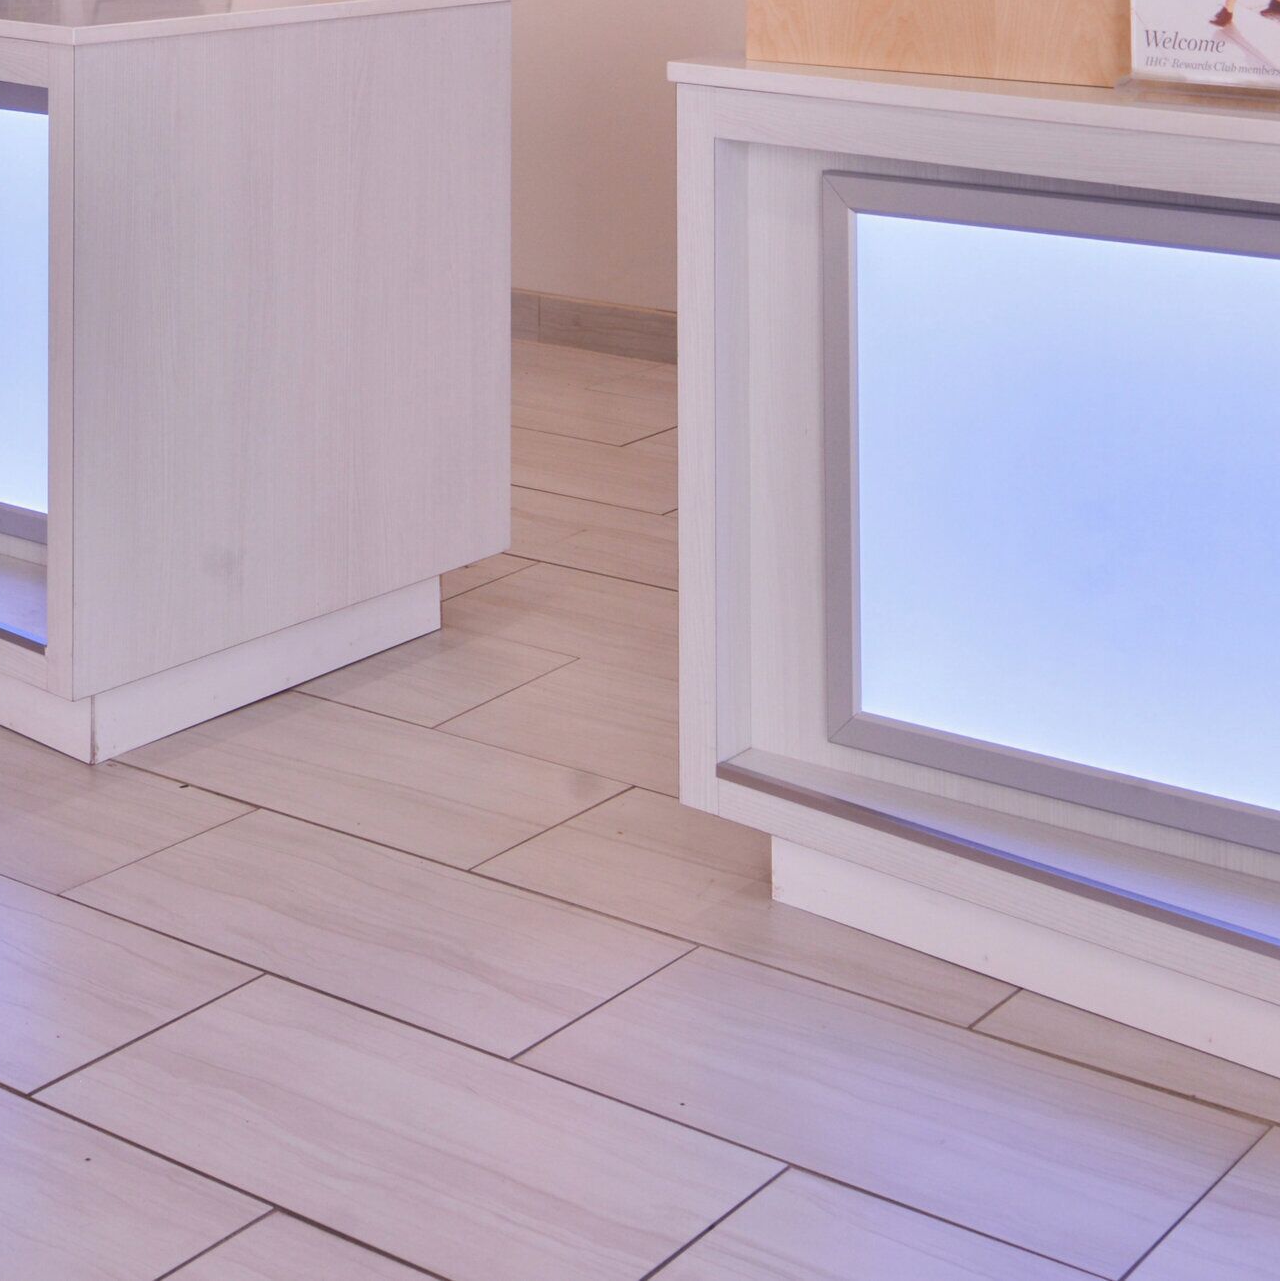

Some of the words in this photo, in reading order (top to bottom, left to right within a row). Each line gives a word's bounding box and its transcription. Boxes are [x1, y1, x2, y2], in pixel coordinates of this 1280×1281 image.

[1144, 29, 1226, 54] Welcome
[1171, 58, 1212, 72] Rewards
[1213, 61, 1237, 73] Club
